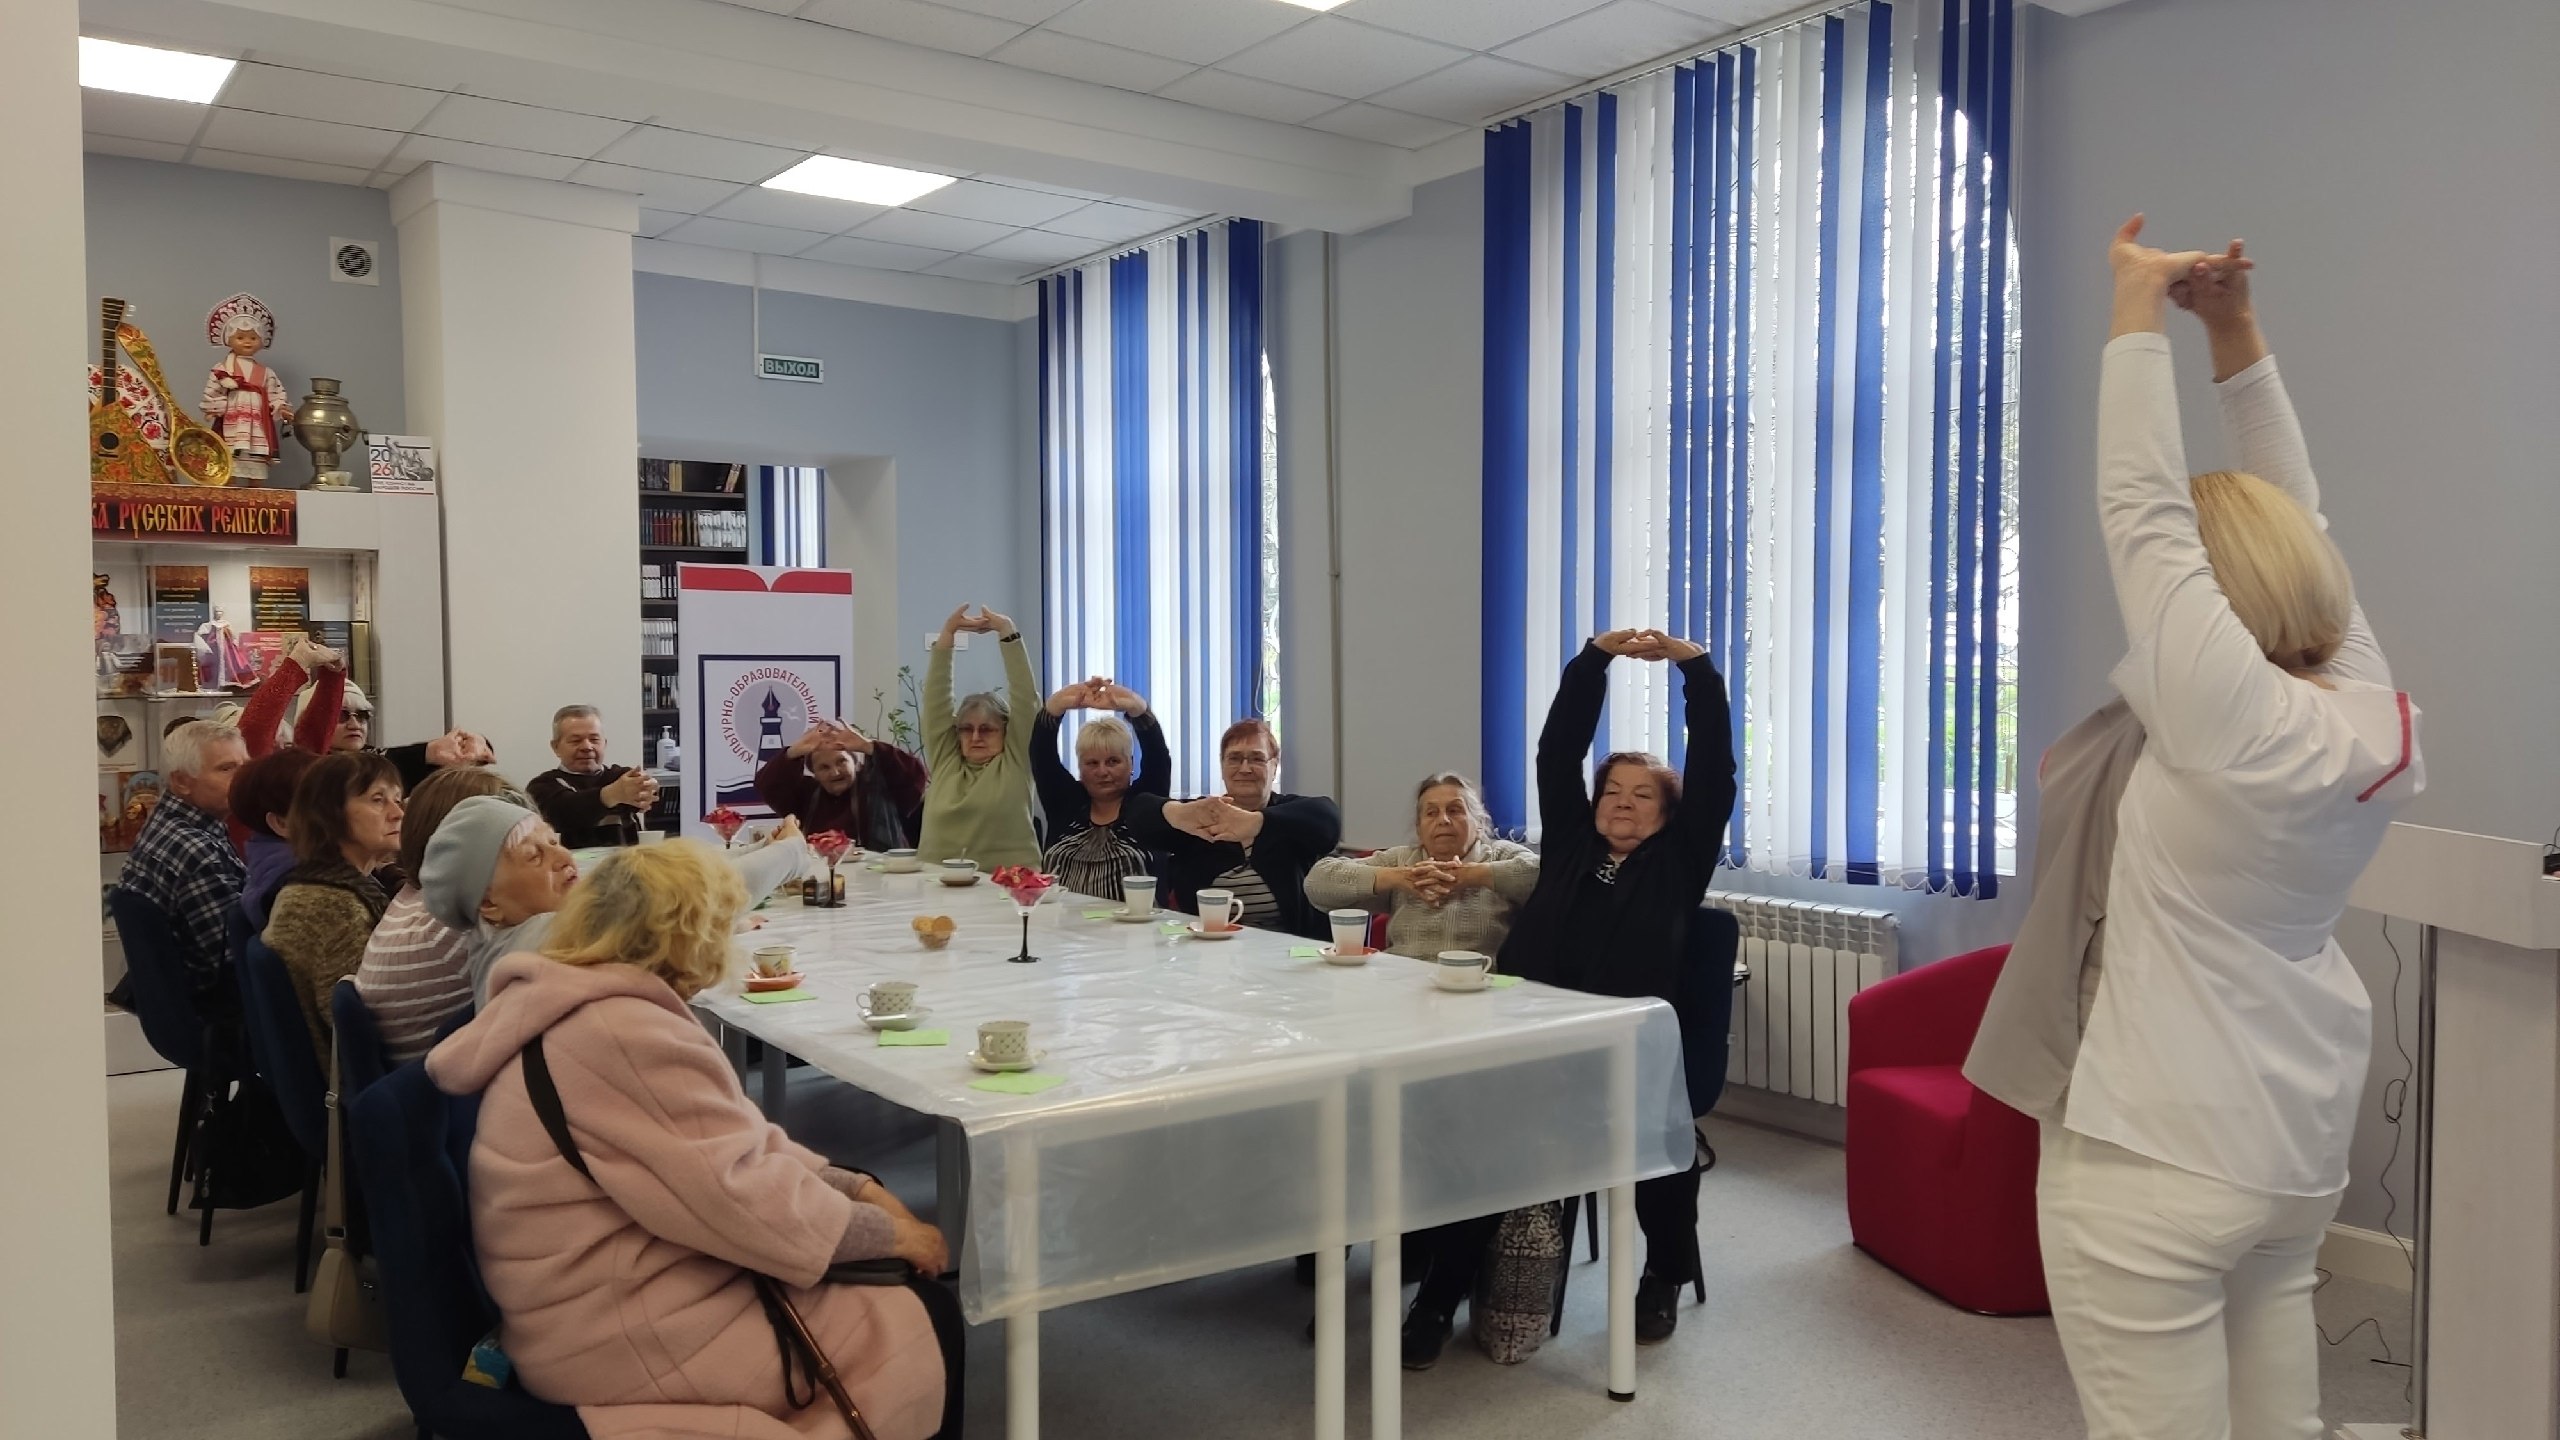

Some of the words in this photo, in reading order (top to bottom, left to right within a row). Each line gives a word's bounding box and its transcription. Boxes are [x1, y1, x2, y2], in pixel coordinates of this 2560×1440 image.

[764, 360, 817, 377] ВЫХОД
[371, 449, 391, 462] 20
[371, 463, 391, 476] 26
[118, 503, 205, 539] РУССКИХ
